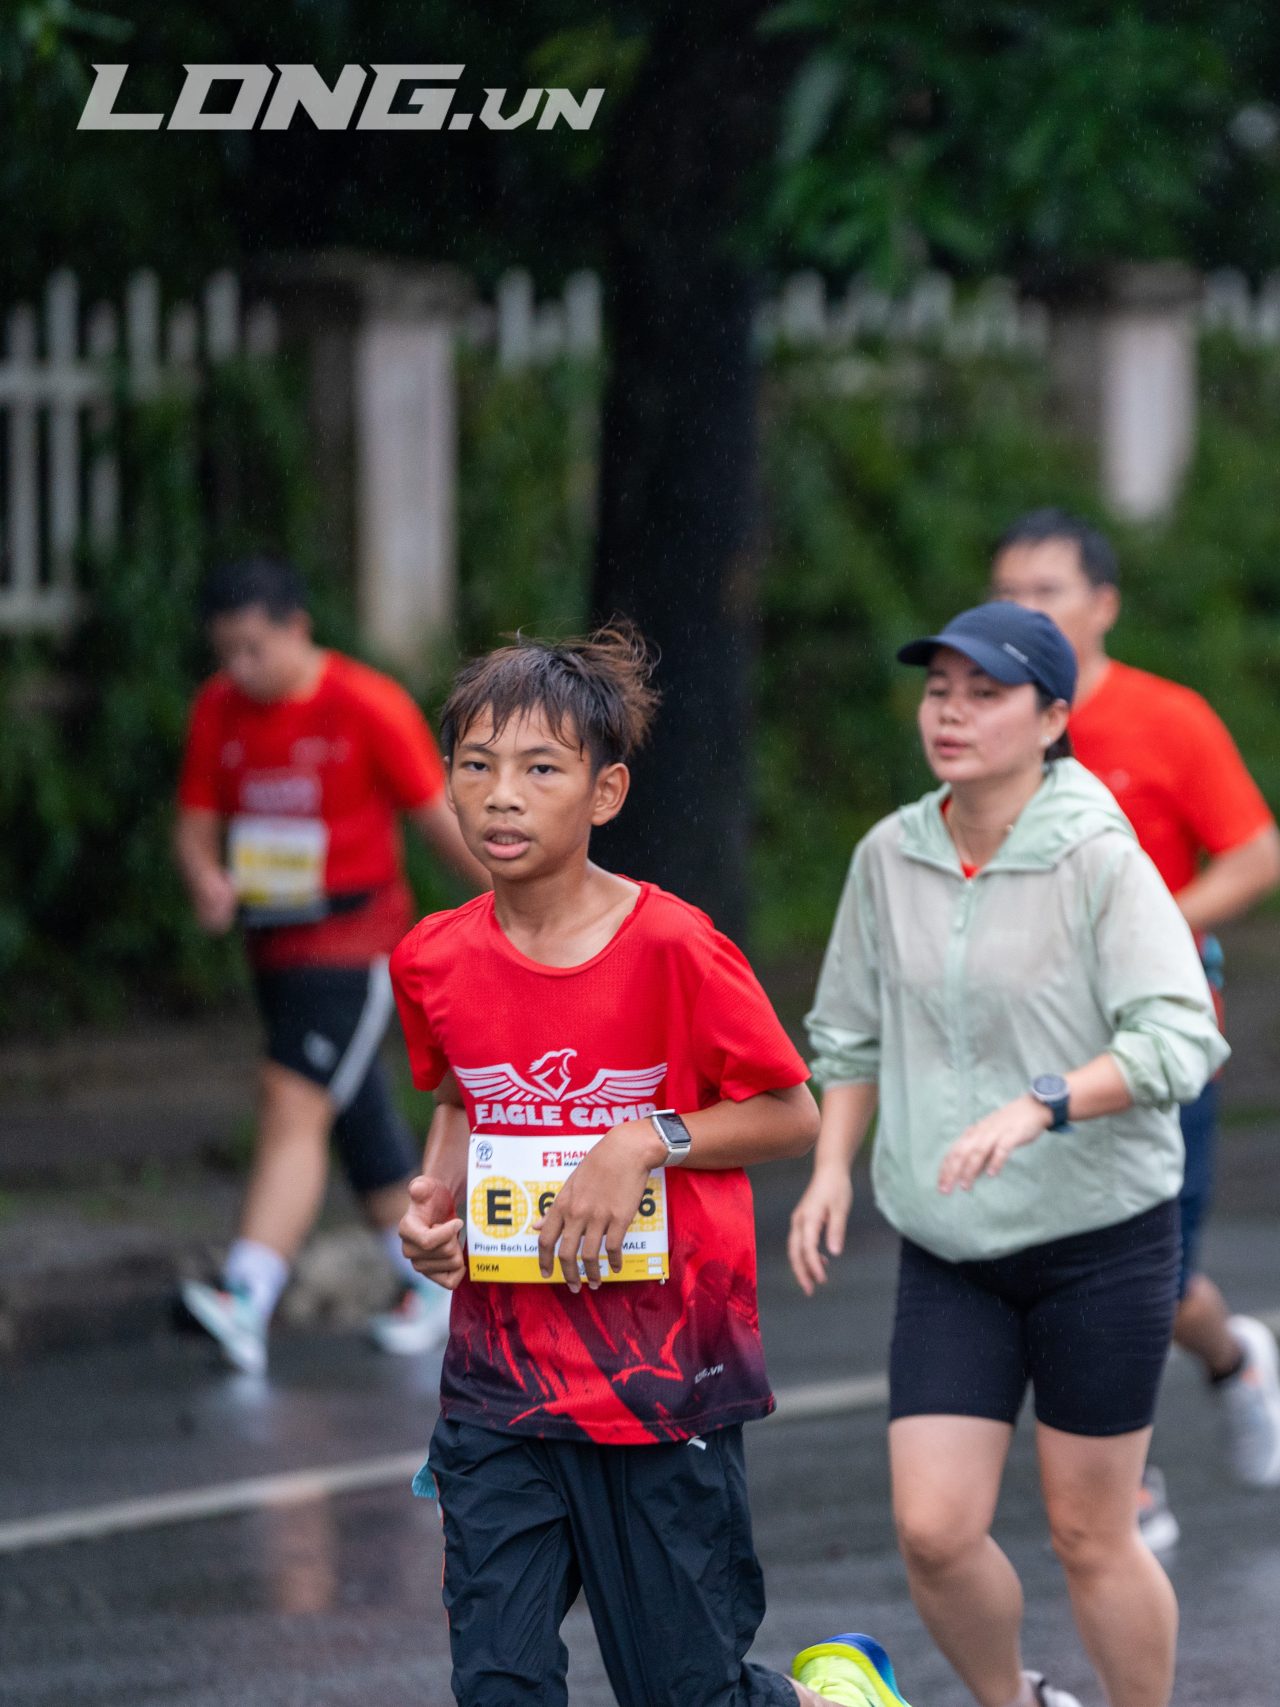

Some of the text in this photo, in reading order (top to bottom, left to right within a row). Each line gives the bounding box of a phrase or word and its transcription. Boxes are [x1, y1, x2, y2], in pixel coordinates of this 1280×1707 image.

[474, 1104, 564, 1127] EAGLE
[563, 1150, 588, 1159] HAN
[486, 1189, 513, 1226] E
[476, 1263, 500, 1272] 10KM
